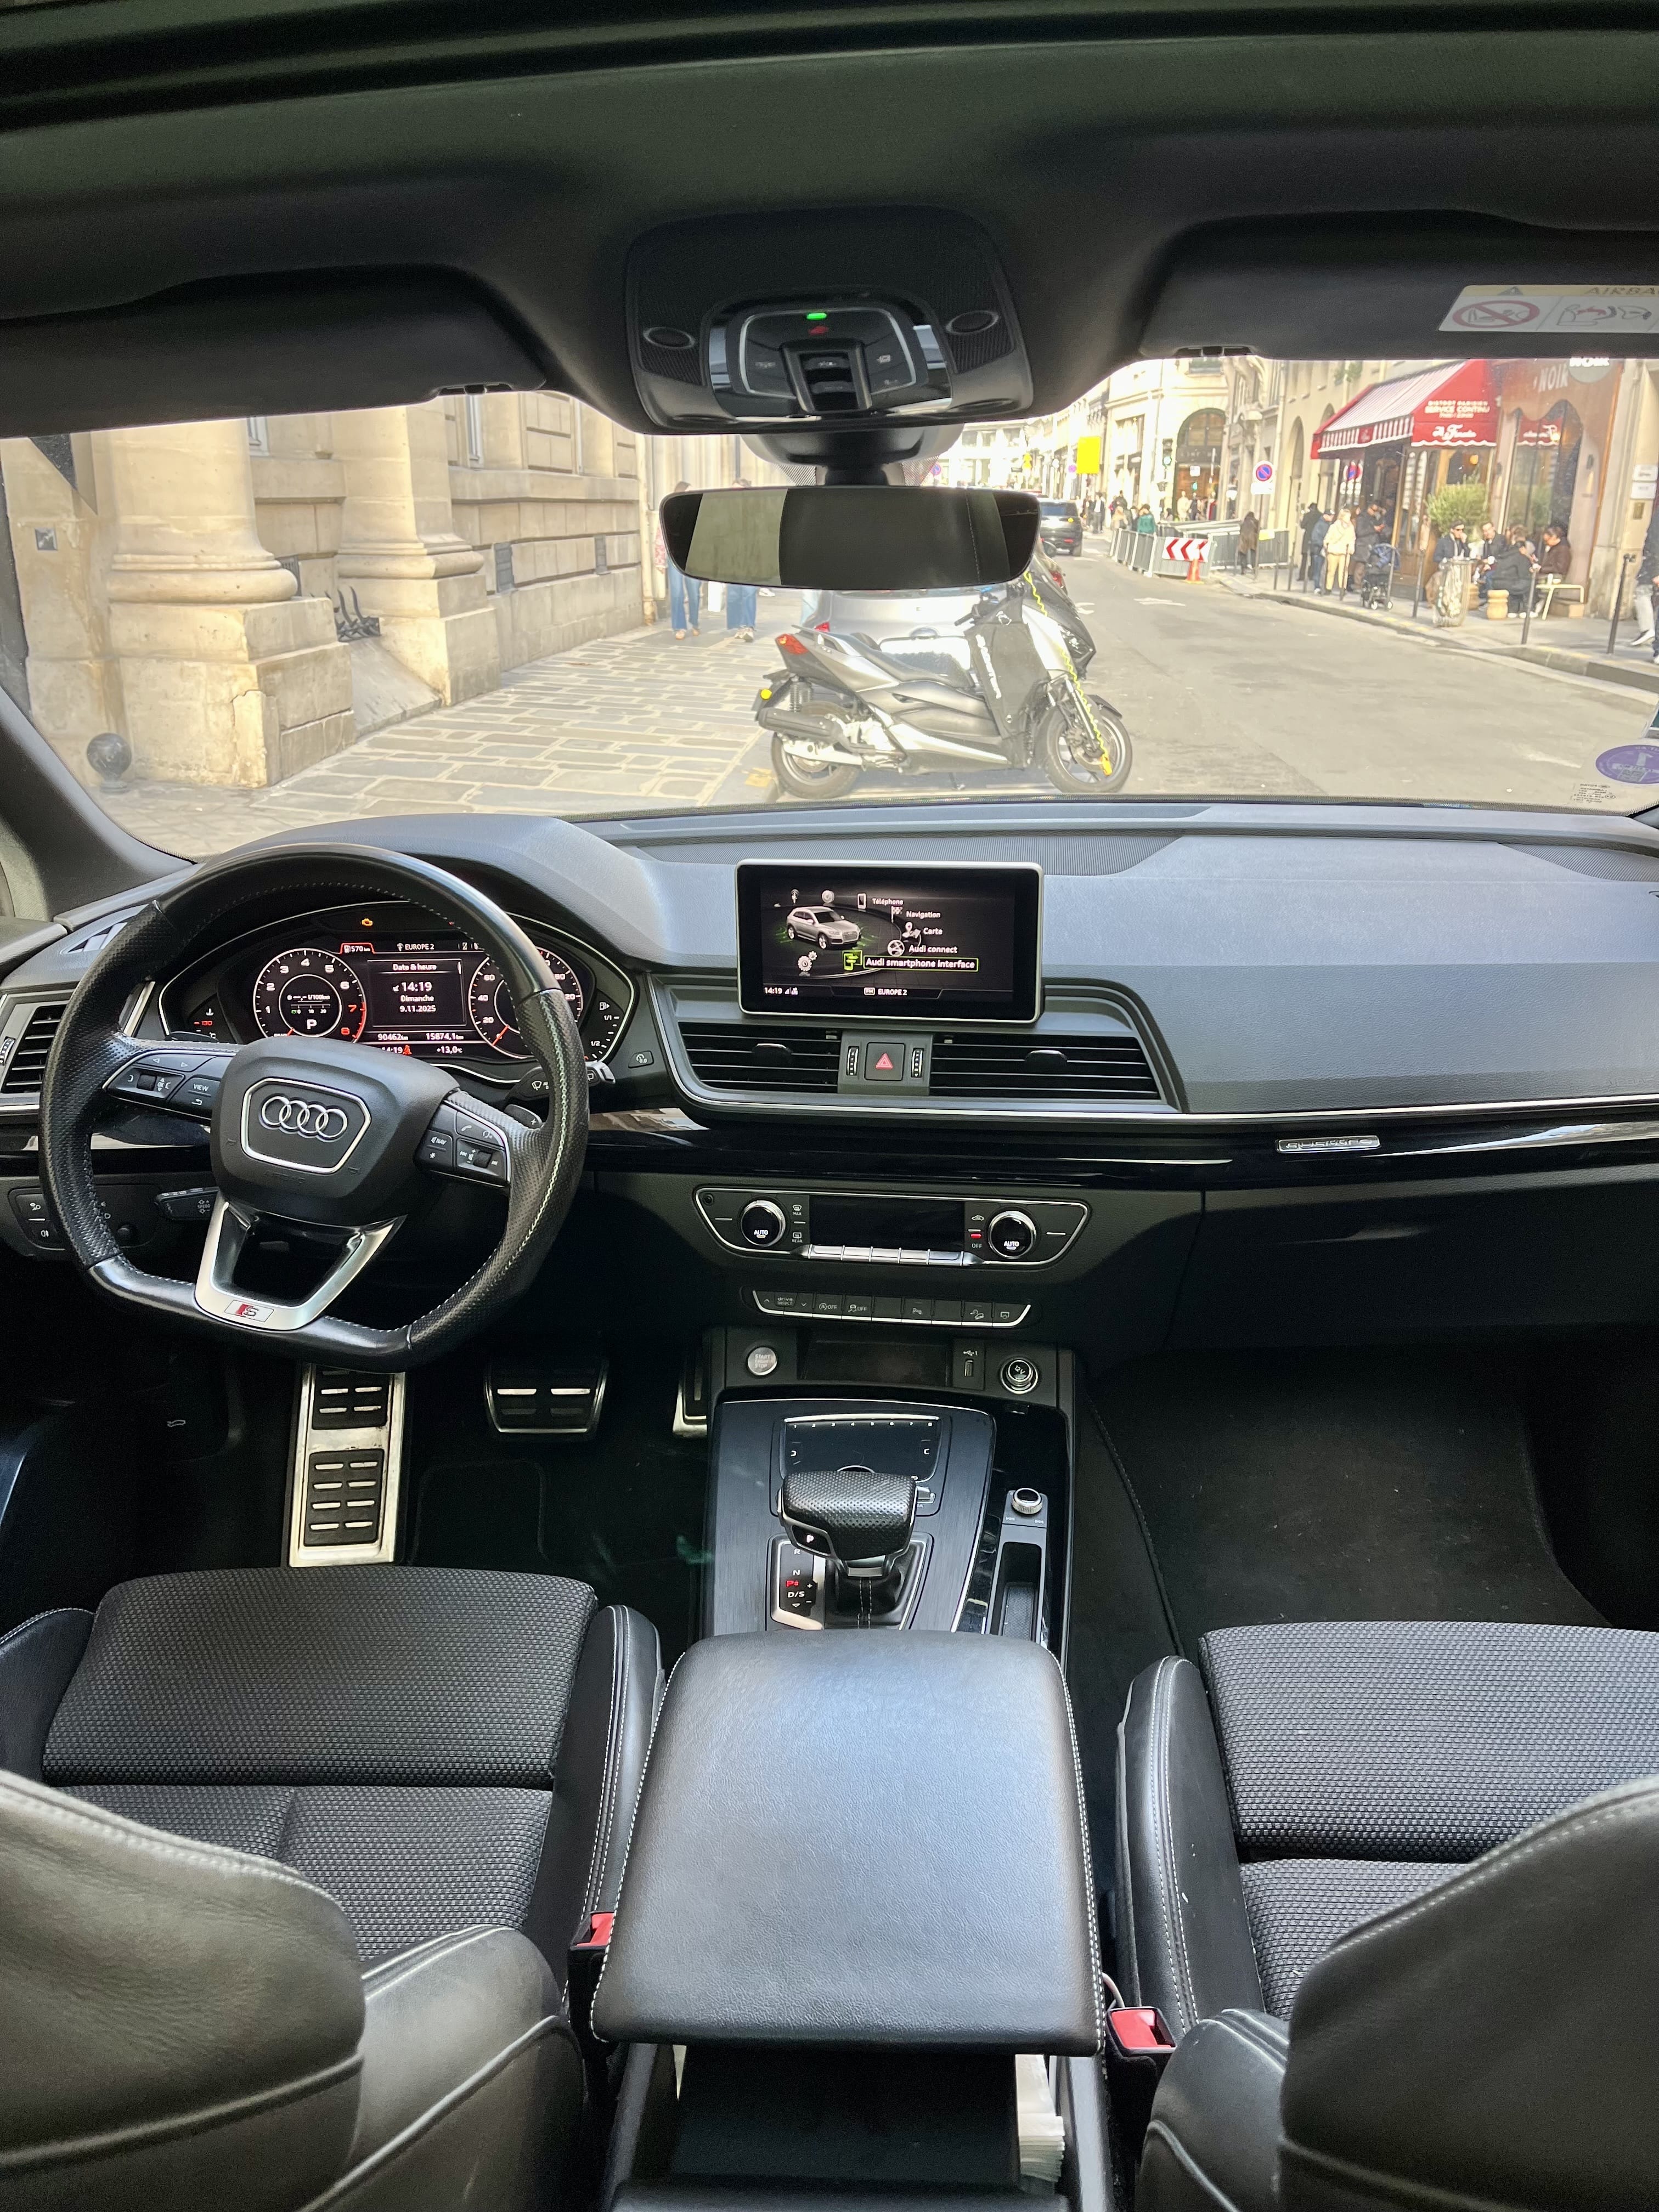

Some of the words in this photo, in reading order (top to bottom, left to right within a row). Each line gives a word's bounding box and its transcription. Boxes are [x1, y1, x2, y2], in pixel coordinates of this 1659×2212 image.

[1584, 287, 1659, 295] AIRBA
[906, 911, 941, 919] Navigation
[301, 958, 310, 966] 4
[866, 957, 885, 966] Audi
[886, 958, 936, 968] smartphone
[938, 960, 975, 968] interface
[280, 965, 289, 974] 3
[325, 964, 334, 973] 5
[266, 983, 275, 991] 2
[340, 981, 349, 990] 6
[401, 982, 432, 992] 14:19
[265, 1006, 270, 1014] 1
[307, 1019, 317, 1030] P
[341, 1027, 350, 1035] 8
[193, 1084, 210, 1092] VIEW
[806, 1534, 814, 1543] P
